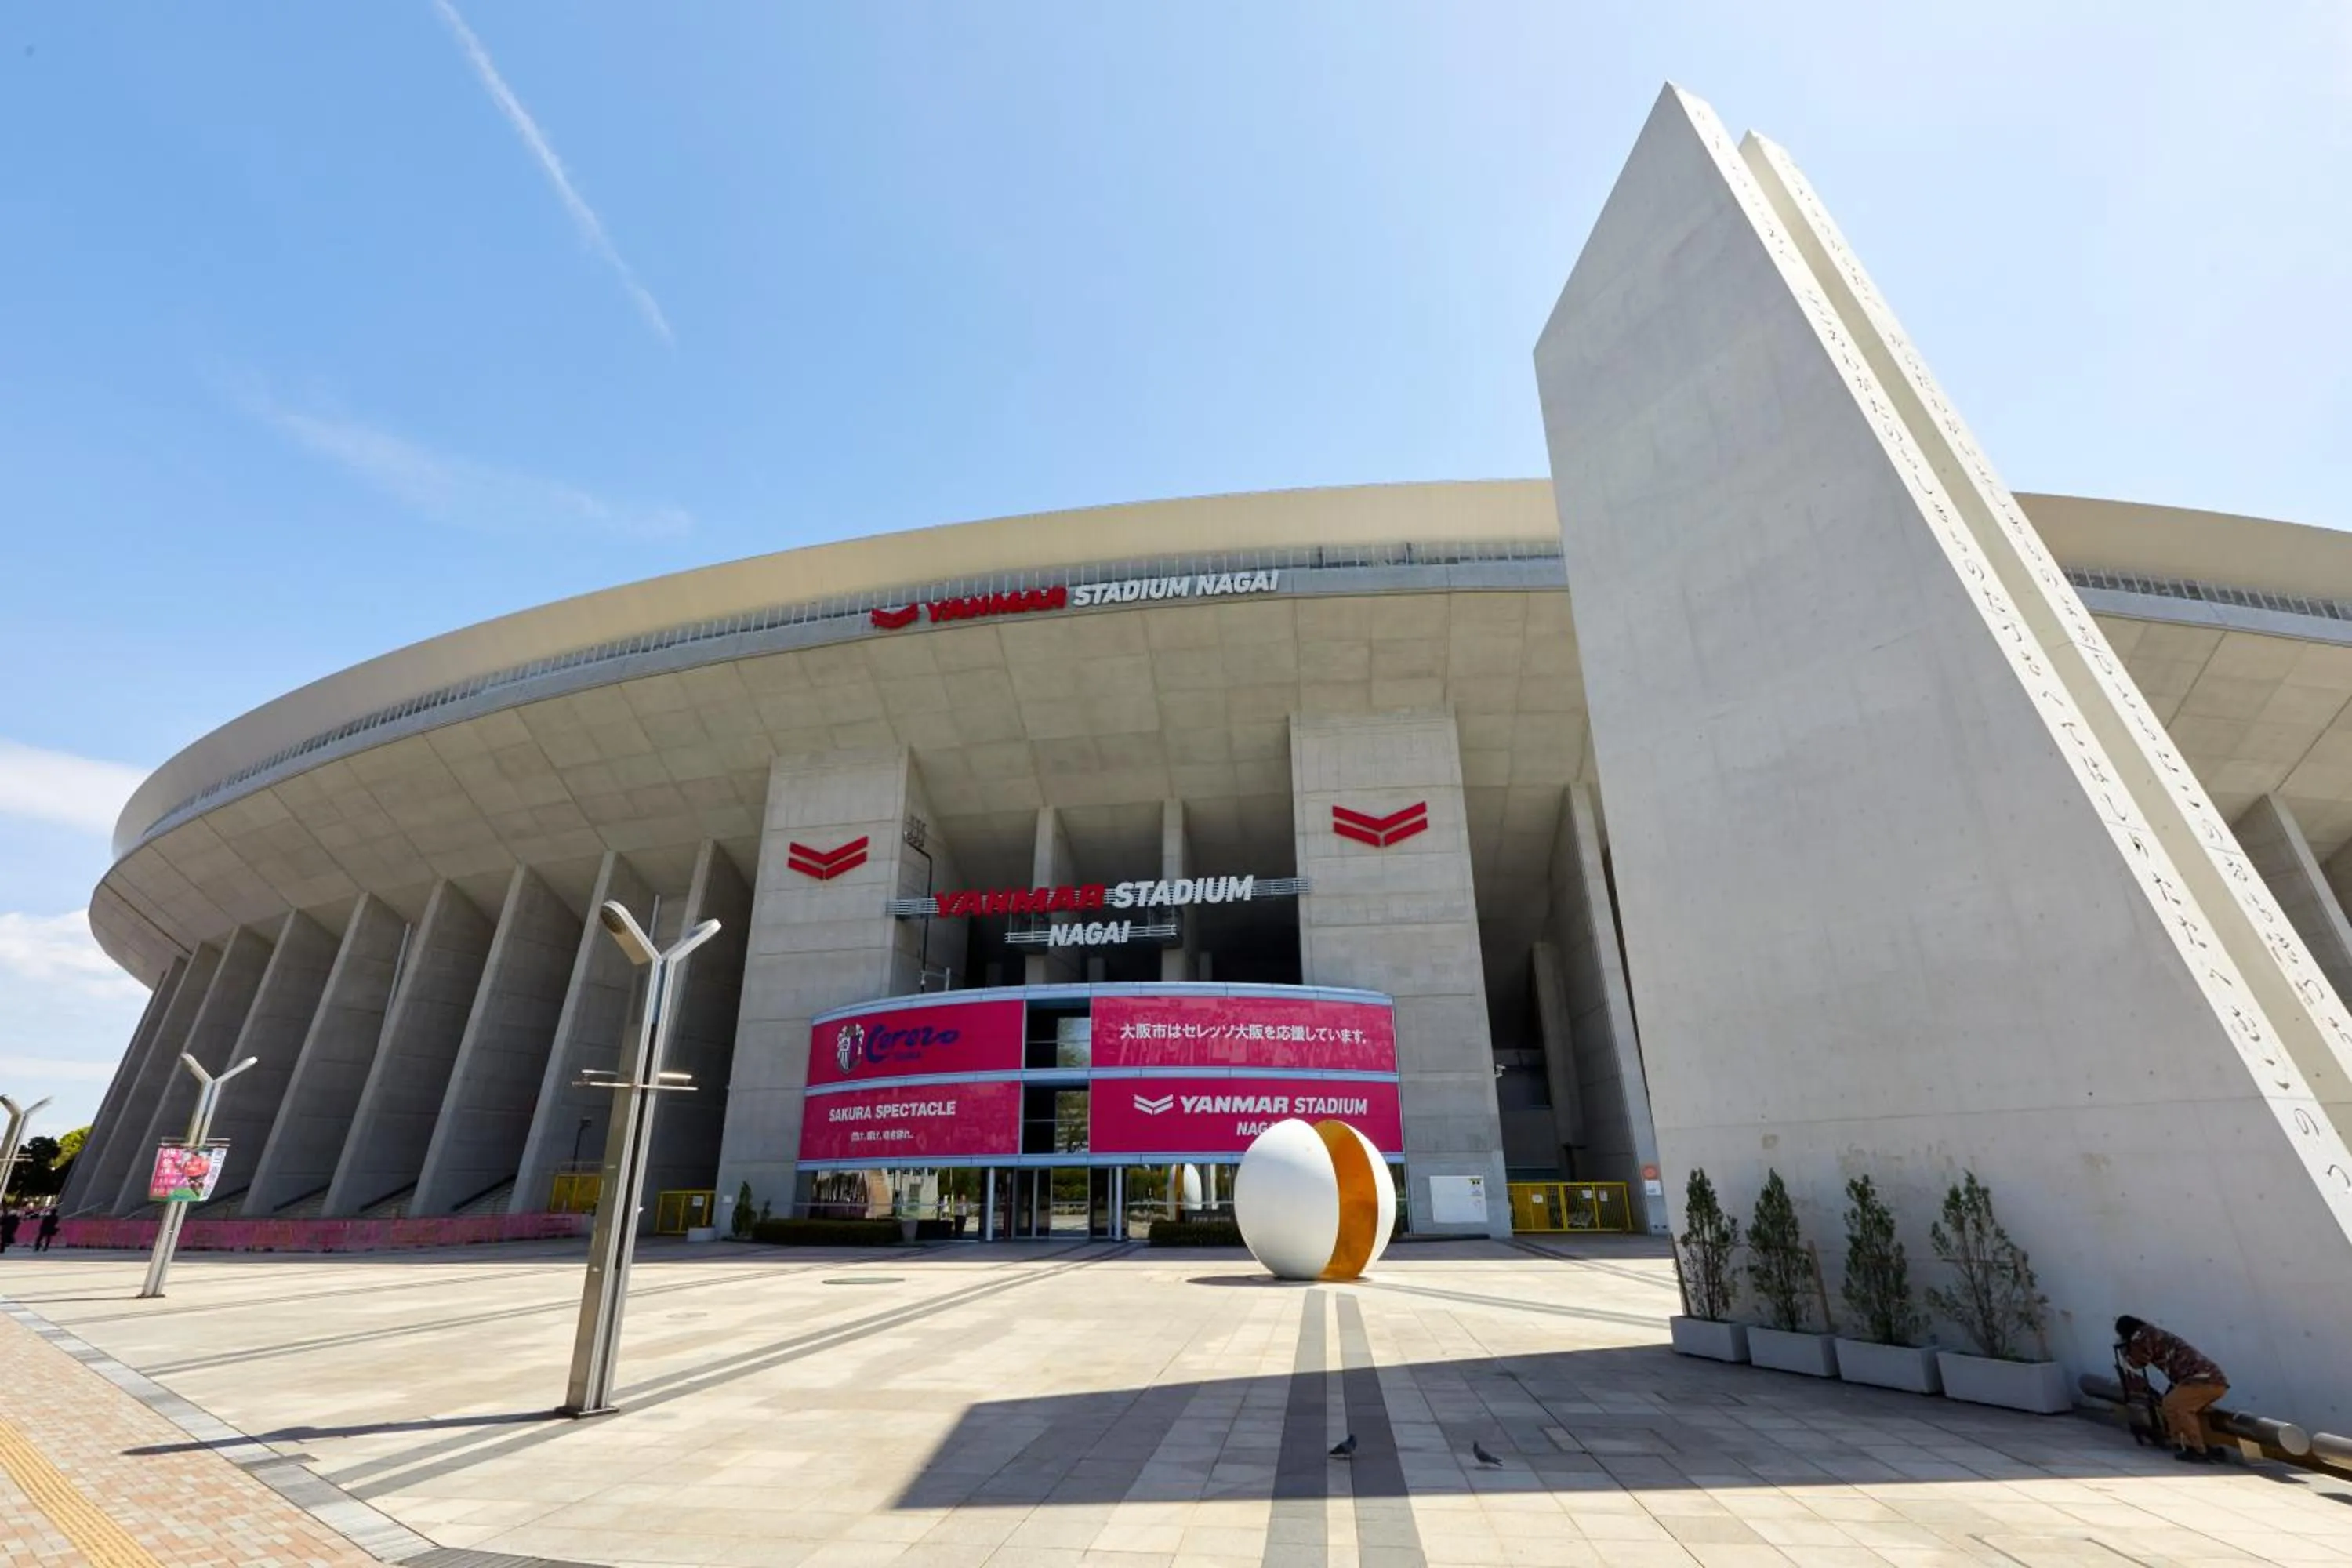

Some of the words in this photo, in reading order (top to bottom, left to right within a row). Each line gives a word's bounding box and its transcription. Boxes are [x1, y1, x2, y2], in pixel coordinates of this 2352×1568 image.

[926, 586, 1067, 622] YANMAR
[1073, 575, 1189, 606] STADIUM
[1195, 569, 1279, 595] NAGAI
[935, 883, 1105, 918] YANMAR
[1112, 874, 1254, 908] STADIUM
[1047, 920, 1131, 947] NAGAI
[828, 1106, 873, 1123] SAKURA
[875, 1100, 957, 1120] SPECTACLE
[1179, 1095, 1290, 1115] YANMAR
[1294, 1098, 1368, 1116] STADIUM
[1236, 1121, 1277, 1137] NAG
